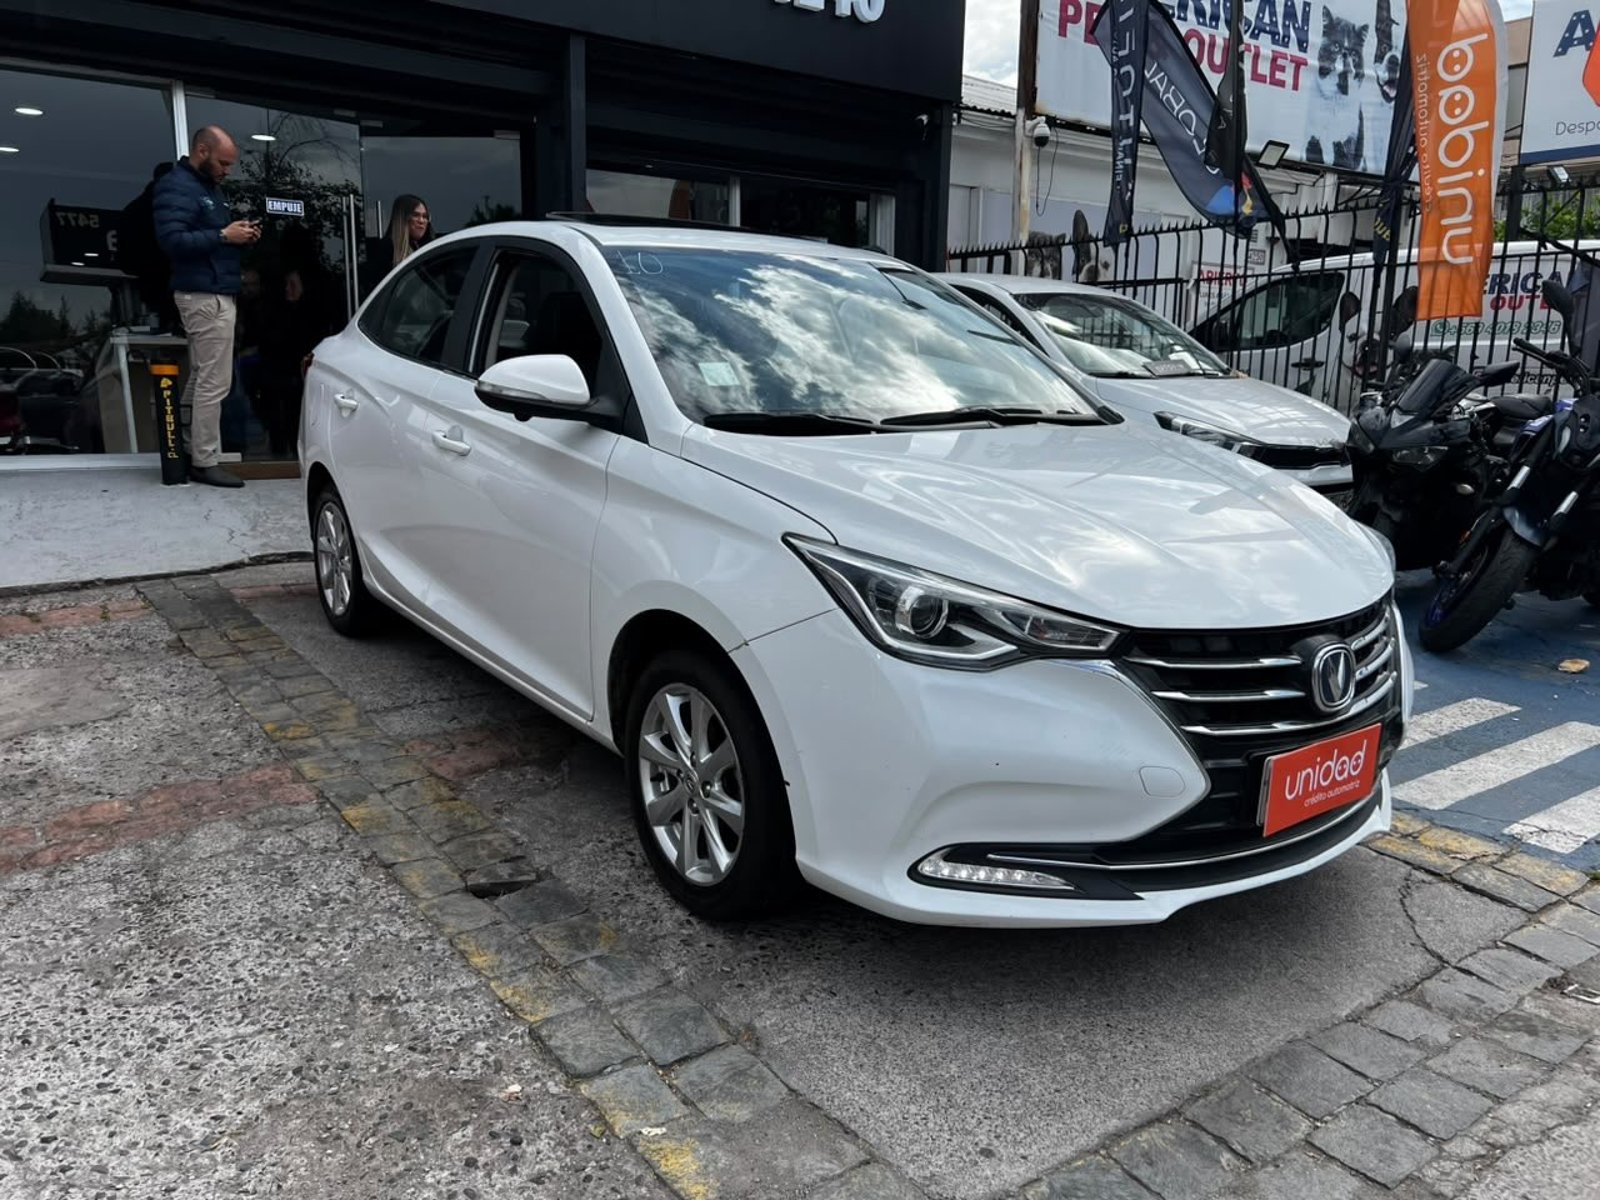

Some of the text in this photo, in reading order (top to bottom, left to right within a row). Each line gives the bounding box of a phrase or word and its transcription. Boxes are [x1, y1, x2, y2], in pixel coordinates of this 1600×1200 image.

[1184, 28, 1308, 92] OULET
[268, 200, 302, 213] EMPUJE
[1285, 739, 1367, 800] unidad
